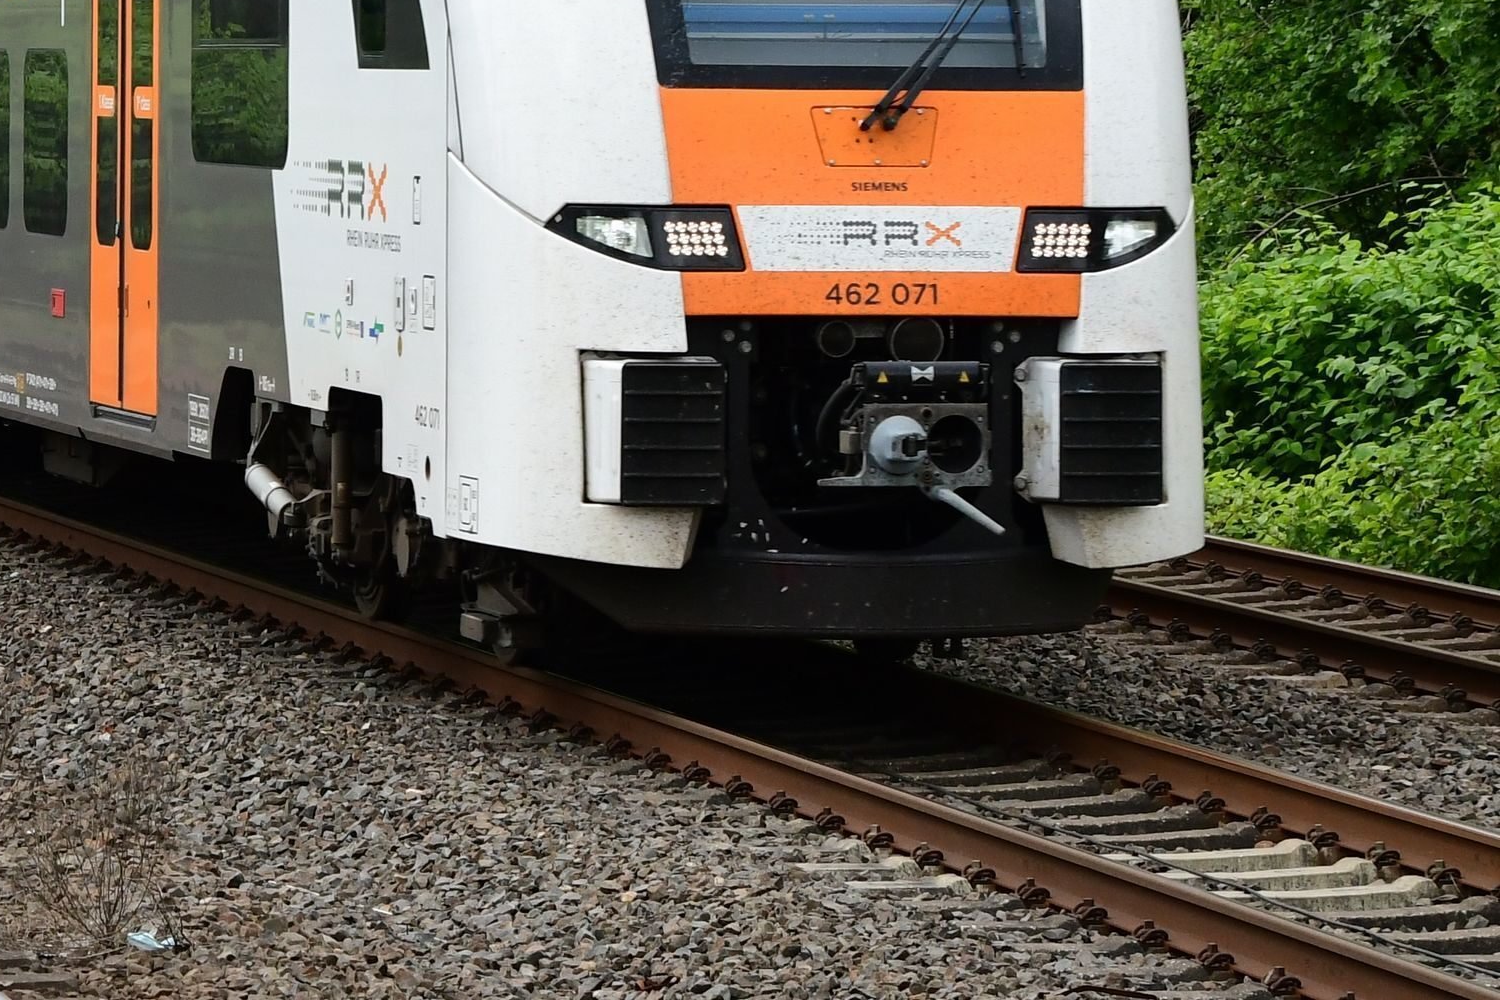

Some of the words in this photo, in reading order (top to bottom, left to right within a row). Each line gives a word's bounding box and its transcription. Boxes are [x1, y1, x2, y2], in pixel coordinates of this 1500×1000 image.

[851, 182, 908, 192] SIEMENS
[825, 283, 880, 306] 462
[891, 283, 939, 305] 071
